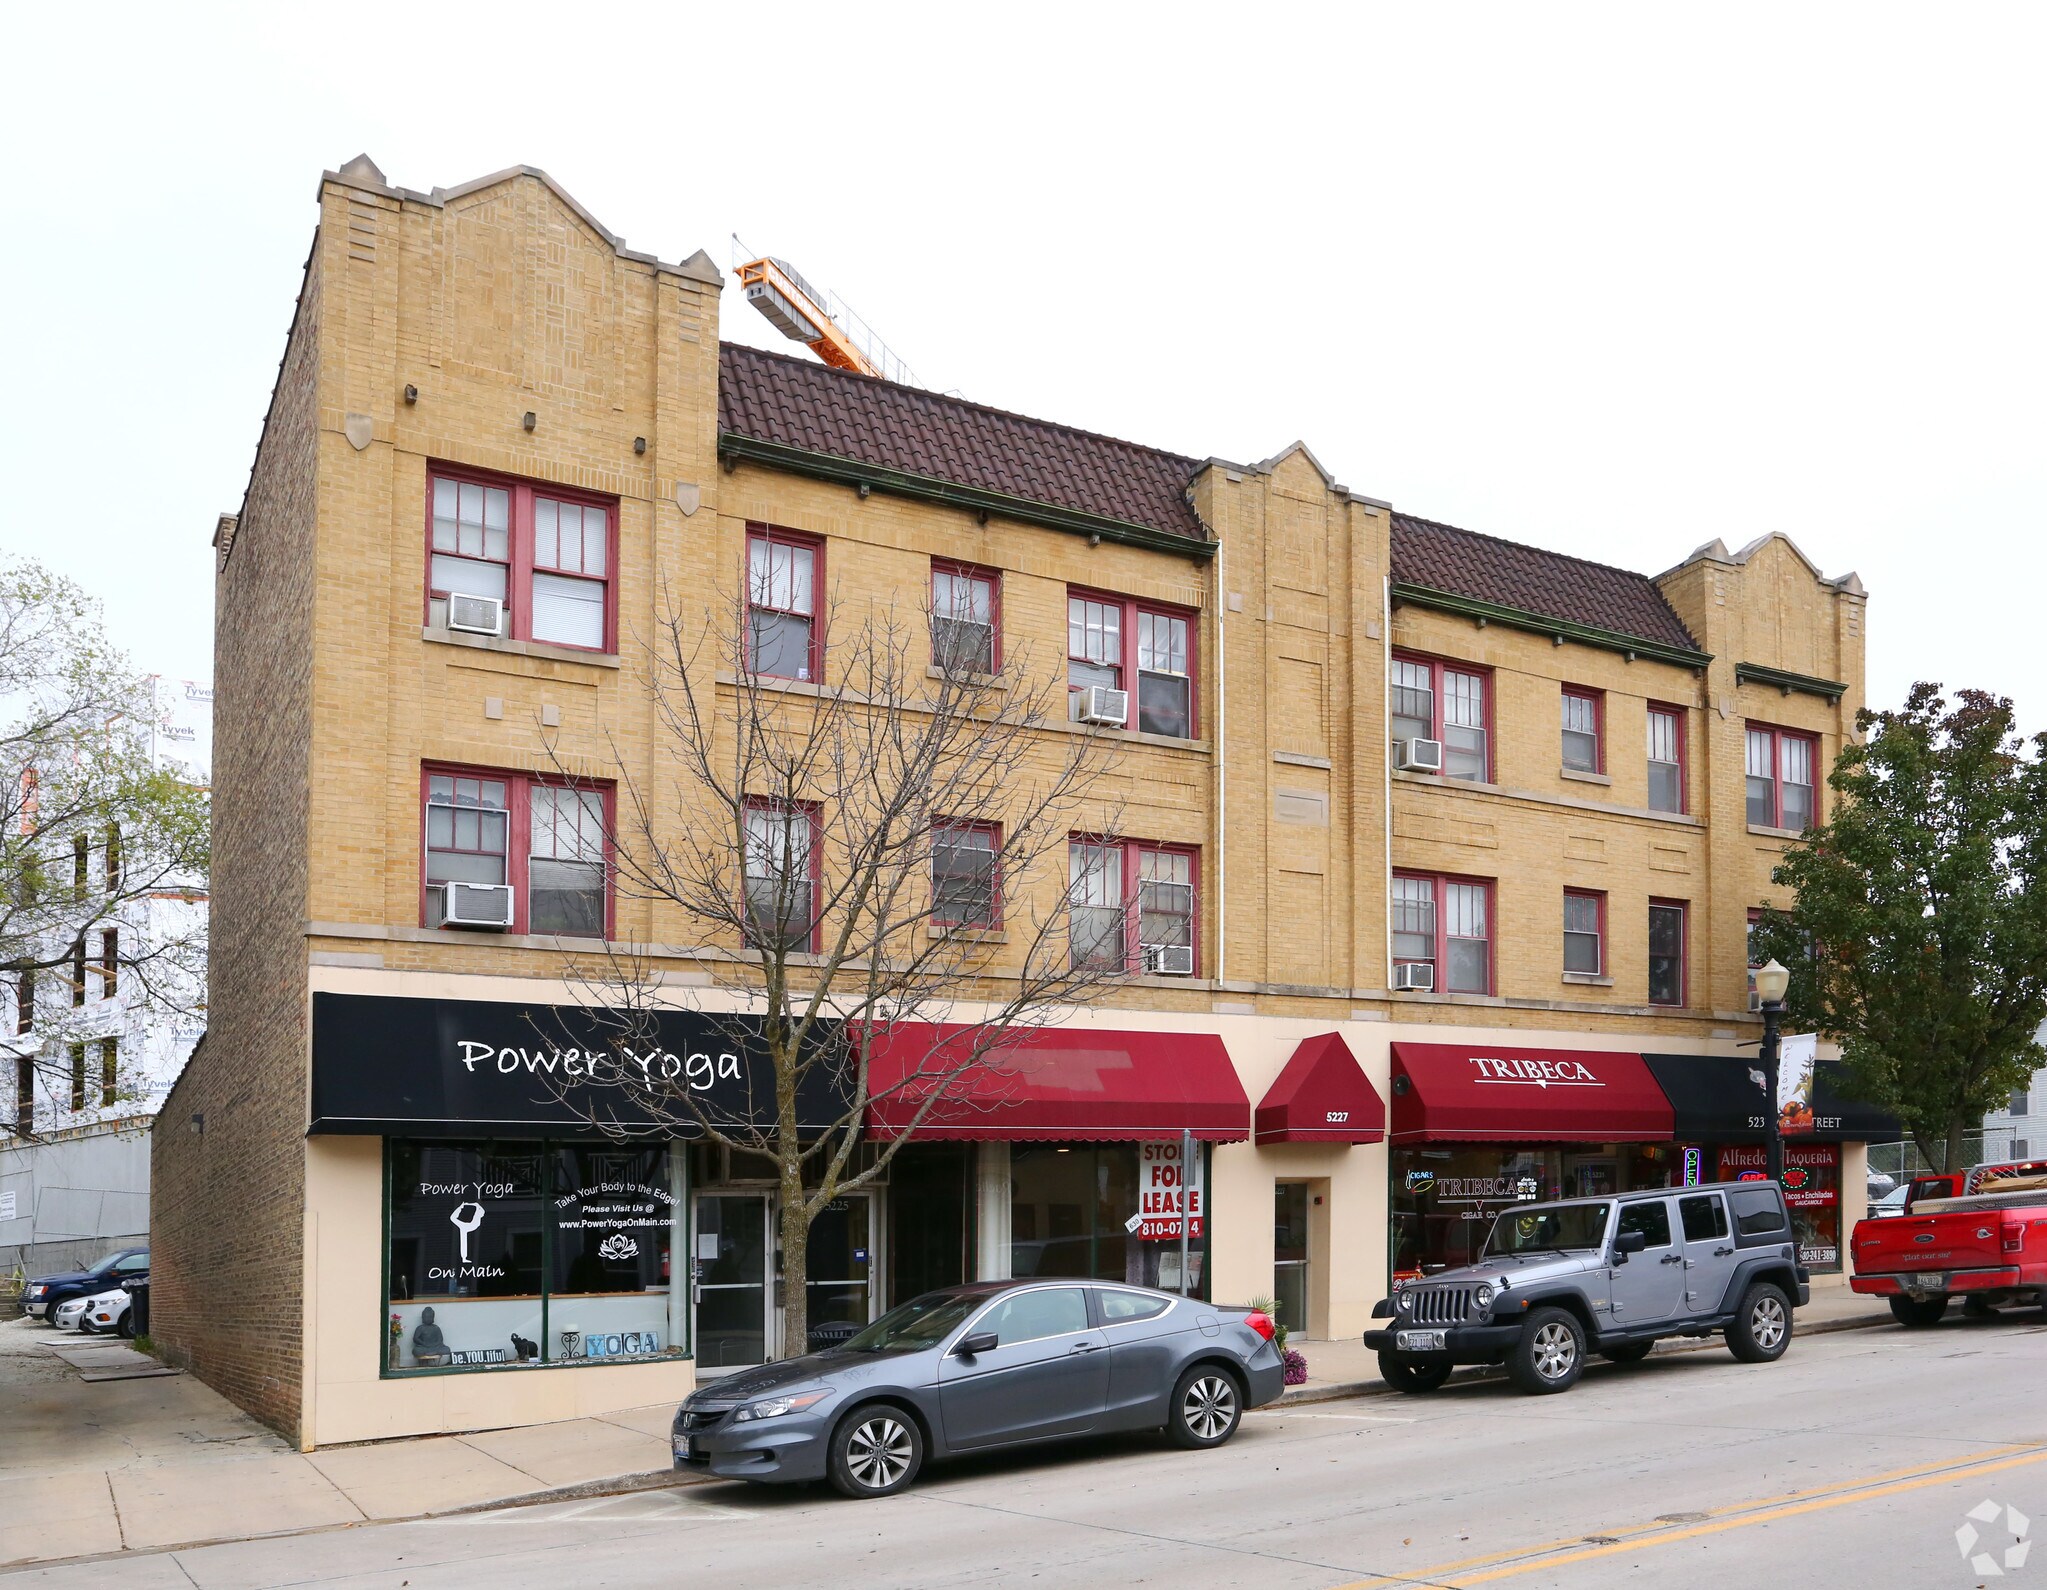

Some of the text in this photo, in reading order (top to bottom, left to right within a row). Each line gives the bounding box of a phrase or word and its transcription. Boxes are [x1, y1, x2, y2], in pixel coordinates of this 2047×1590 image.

[162, 723, 195, 736] Tyvek
[457, 1040, 742, 1092] Power Yoga
[1468, 1057, 1597, 1081] TRIBECA
[1326, 1111, 1349, 1122] 5227
[1748, 1116, 1765, 1128] 523
[1811, 1117, 1842, 1128] TREET
[1144, 1144, 1199, 1160] STO
[1410, 1171, 1434, 1180] CIGARS
[1686, 1150, 1697, 1187] OPEN
[420, 1181, 514, 1200] Power Yoga
[1437, 1177, 1518, 1197] TRIBECA
[554, 1181, 681, 1209] Take Your Body to the Edge!
[1784, 1191, 1833, 1200] Tacos Enchiladas
[582, 1203, 655, 1213] Please Visit Us @
[825, 1200, 849, 1211] 5225
[1461, 1211, 1483, 1220] CIGAR
[559, 1217, 677, 1229] www.PowerYogaOnMain.com
[1129, 1219, 1140, 1230] 630
[1142, 1221, 1200, 1236] 810-074
[428, 1265, 505, 1279] On Main
[586, 1333, 658, 1357] YOGA
[451, 1349, 506, 1365] be.YOU.tiful
